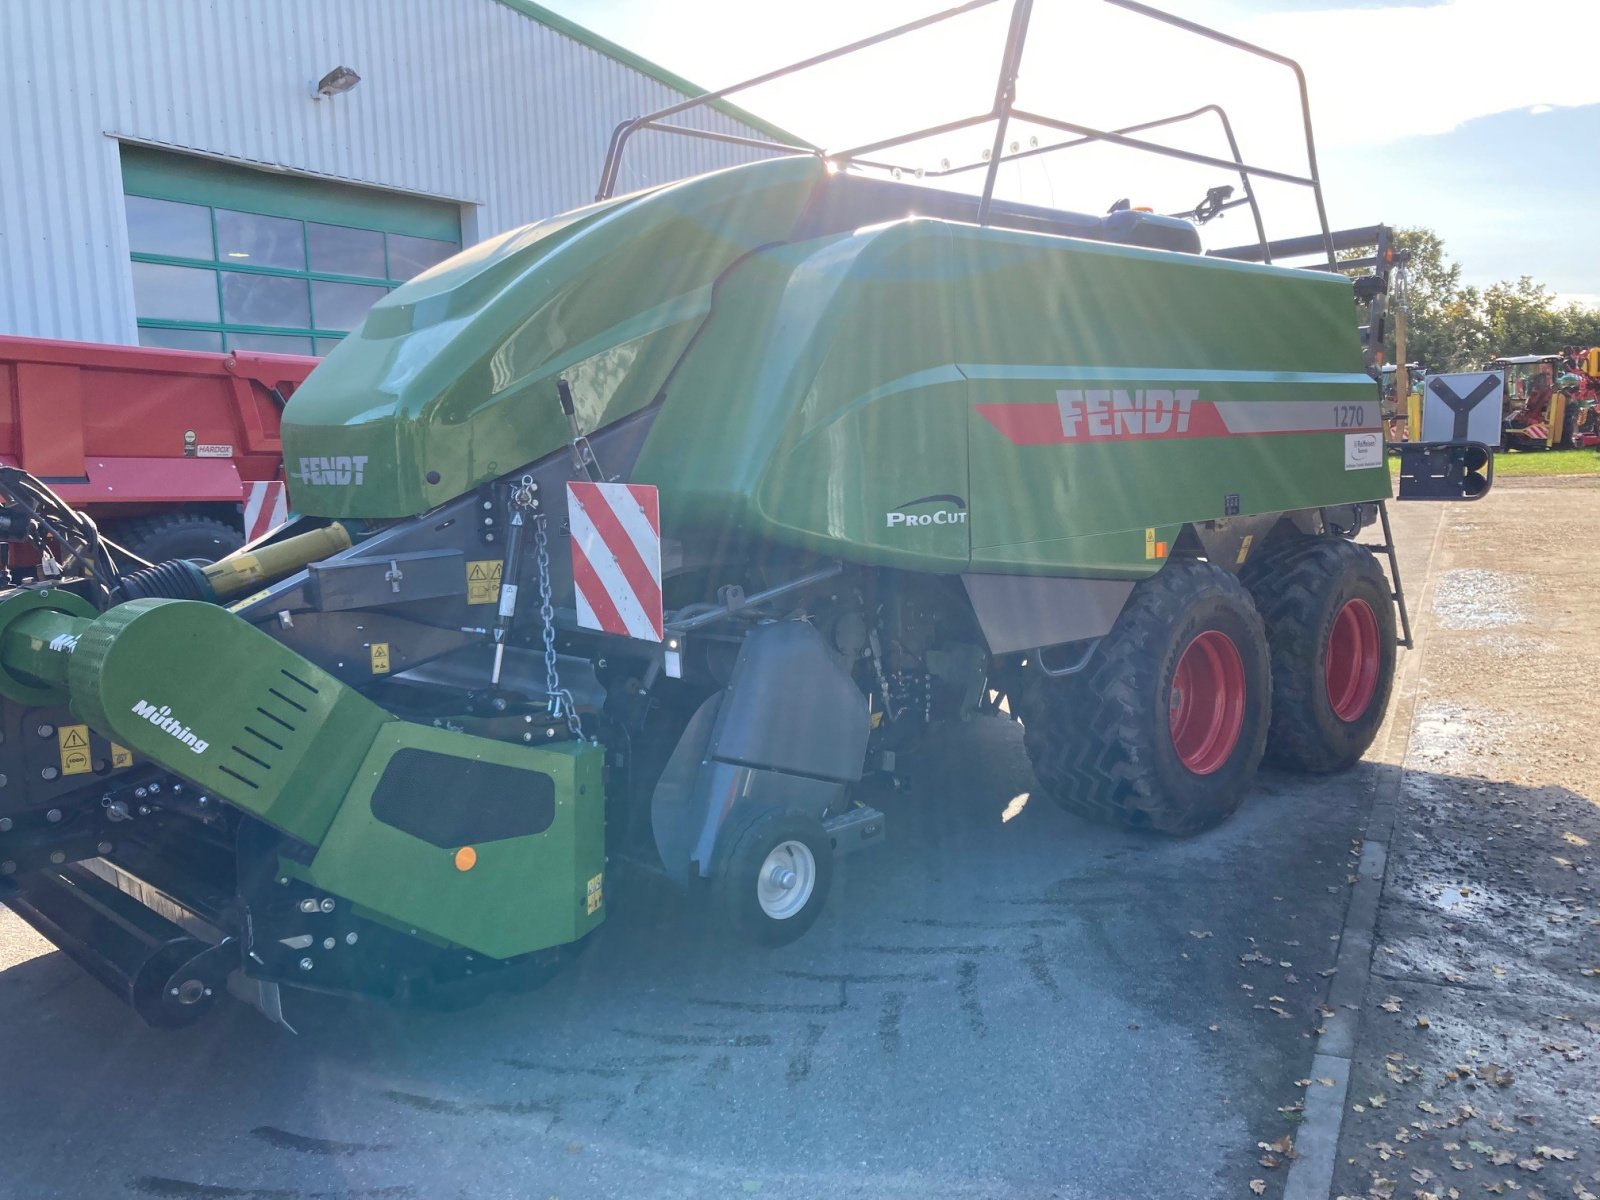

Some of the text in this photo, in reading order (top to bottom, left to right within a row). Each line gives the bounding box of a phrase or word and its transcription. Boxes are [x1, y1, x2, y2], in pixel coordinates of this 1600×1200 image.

[1055, 389, 1200, 437] FENDT
[1333, 405, 1364, 428] 1270
[299, 455, 369, 486] FENDT
[131, 699, 210, 754] Müthing
